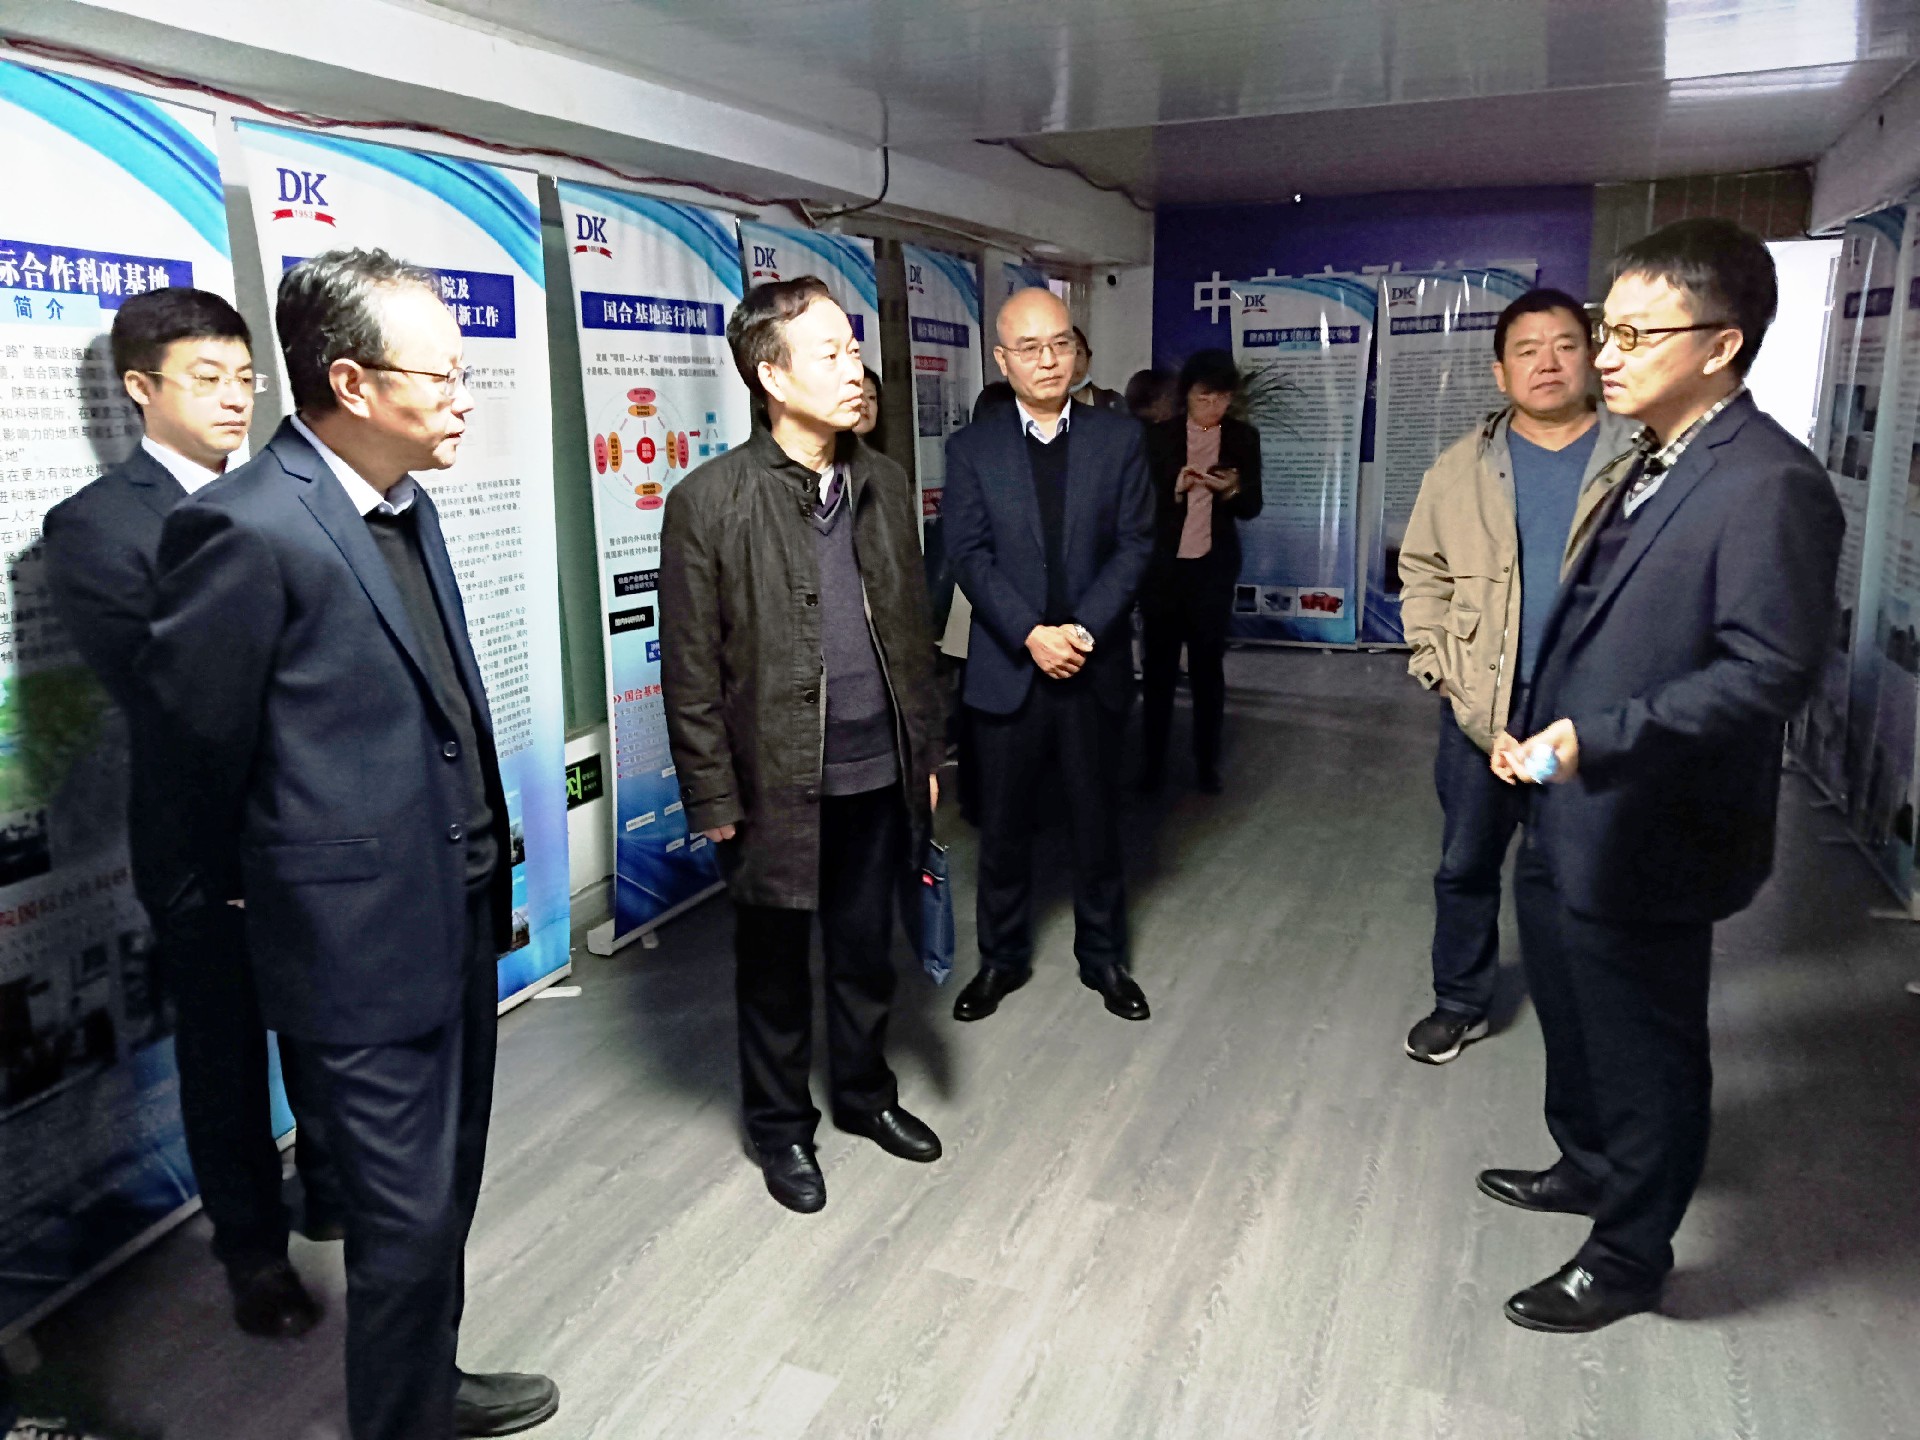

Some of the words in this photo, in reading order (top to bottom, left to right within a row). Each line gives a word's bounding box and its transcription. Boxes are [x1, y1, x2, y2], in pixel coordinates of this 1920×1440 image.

[276, 168, 328, 206] DK
[576, 214, 607, 243] DK
[753, 246, 777, 269] DK
[909, 265, 922, 284] DK
[1244, 294, 1266, 308] DK
[1391, 287, 1417, 300] DK
[13, 295, 64, 320] 简介
[603, 300, 707, 328] 国合基地运行机制
